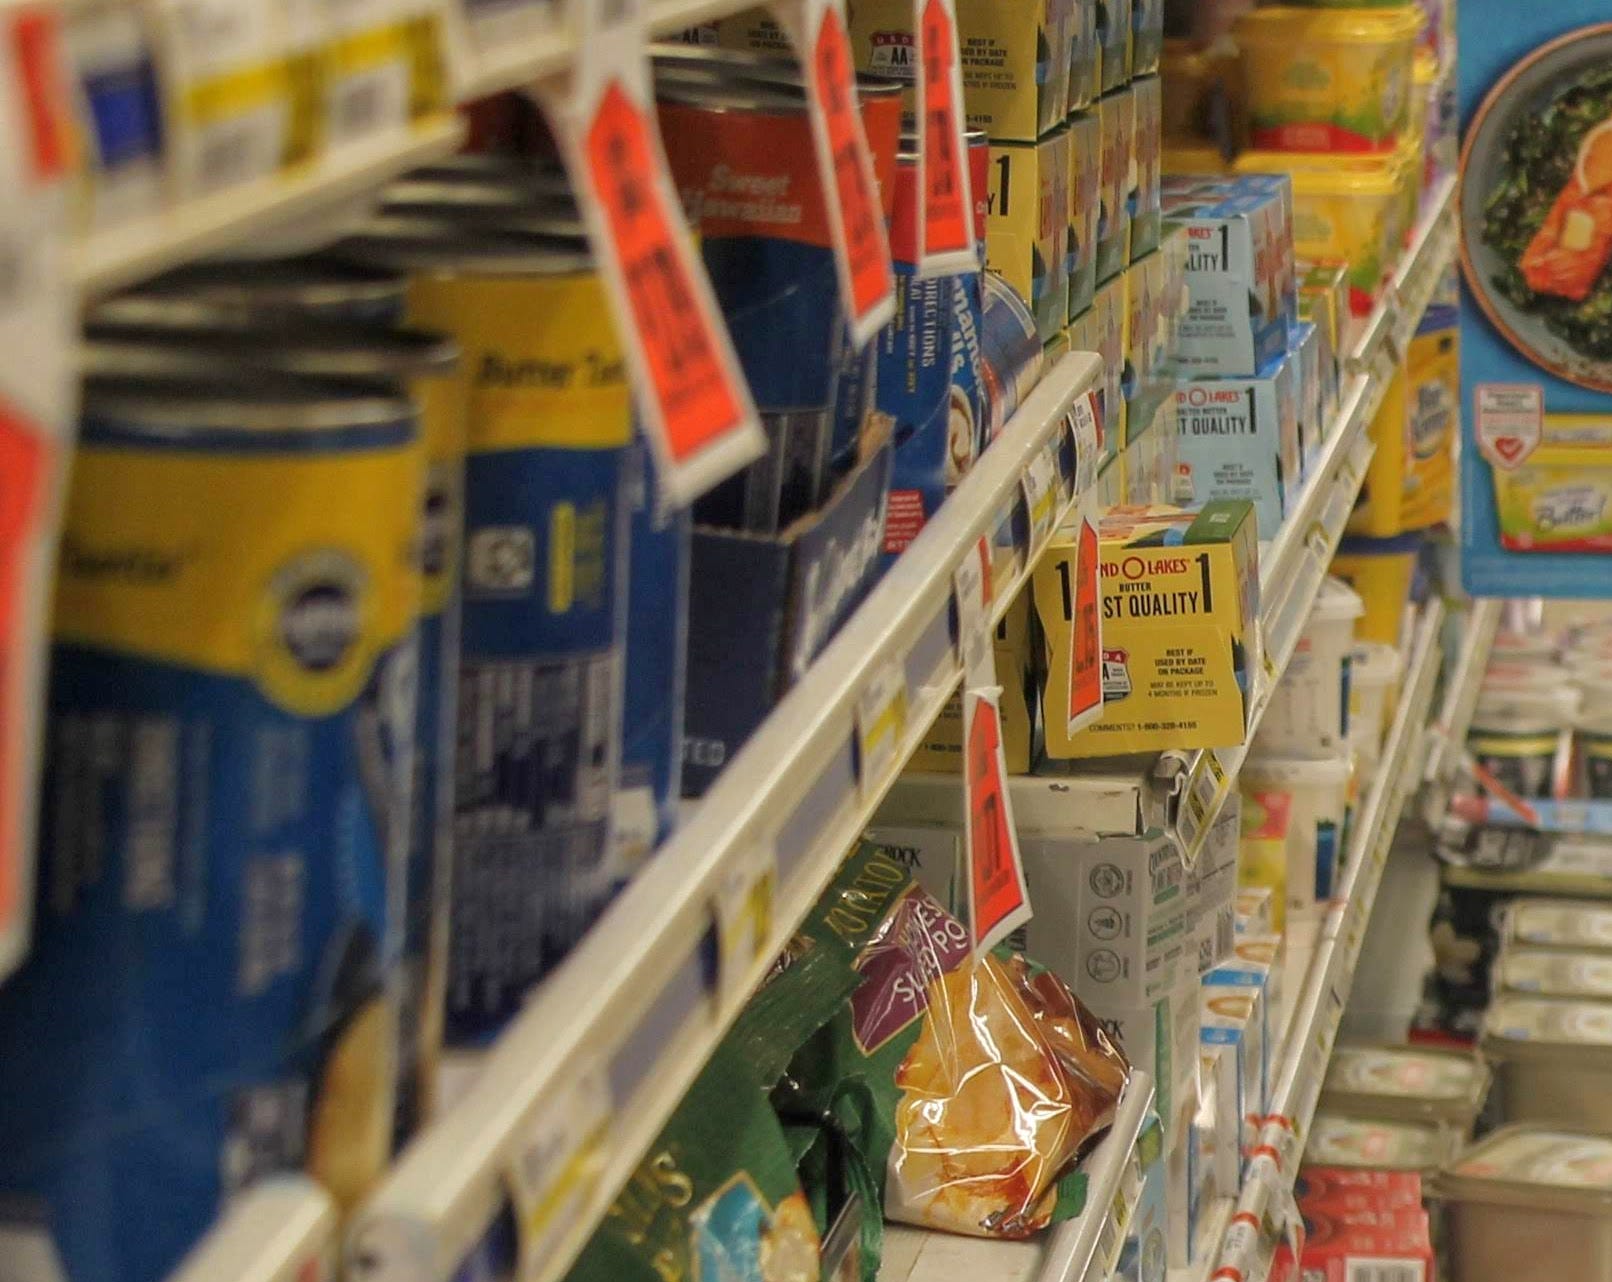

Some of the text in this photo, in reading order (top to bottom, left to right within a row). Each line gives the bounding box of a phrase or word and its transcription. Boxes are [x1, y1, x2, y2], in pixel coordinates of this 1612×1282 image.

[1218, 224, 1229, 272] 1
[1192, 415, 1248, 436] QUALITY
[1245, 386, 1257, 435] 1
[1148, 558, 1189, 576] LAKES
[1195, 553, 1213, 614] 1
[1055, 560, 1073, 622] 1
[1119, 582, 1152, 594] BUTTER
[1129, 591, 1199, 619] QUALITY
